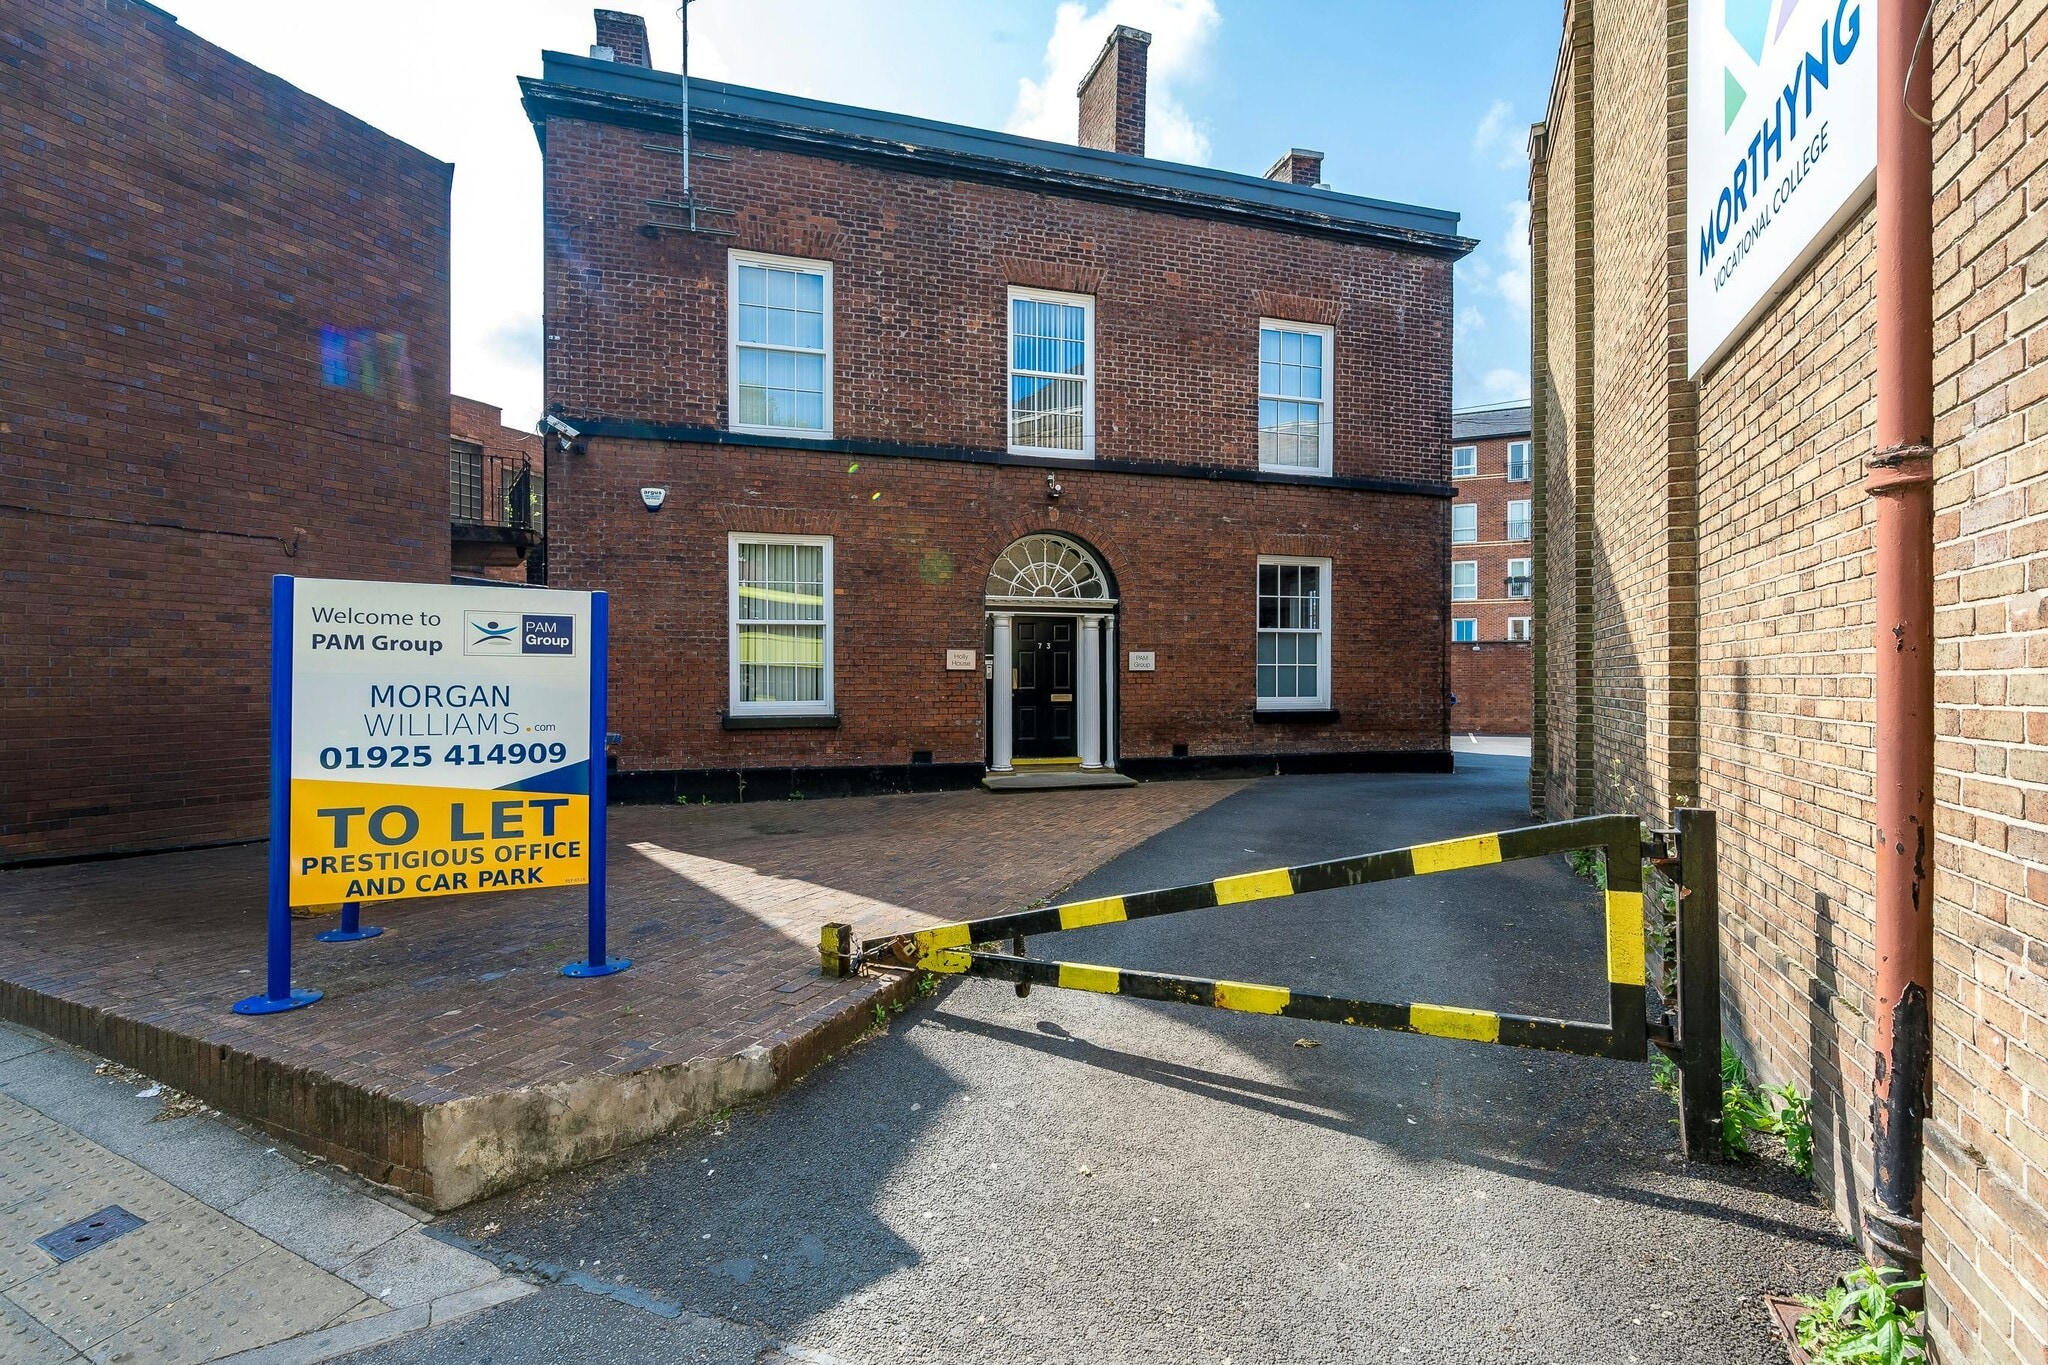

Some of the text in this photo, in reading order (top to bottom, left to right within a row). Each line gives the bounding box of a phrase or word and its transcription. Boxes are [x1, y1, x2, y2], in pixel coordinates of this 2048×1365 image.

[1699, 0, 1860, 276] MORTHYNG
[1714, 121, 1829, 293] VOCATIONAL COLLEGE
[312, 607, 441, 627] Welcome to
[312, 634, 443, 655] PAM Group
[526, 621, 569, 648] PAM Group
[371, 685, 510, 708] MORGAN
[364, 712, 519, 737] WILLIAMS
[320, 742, 567, 769] 01925 414909
[317, 798, 569, 848] TO LET
[301, 841, 581, 876] PRESTIGIOUS OFFICE
[345, 866, 544, 897] AND CAR PARK
